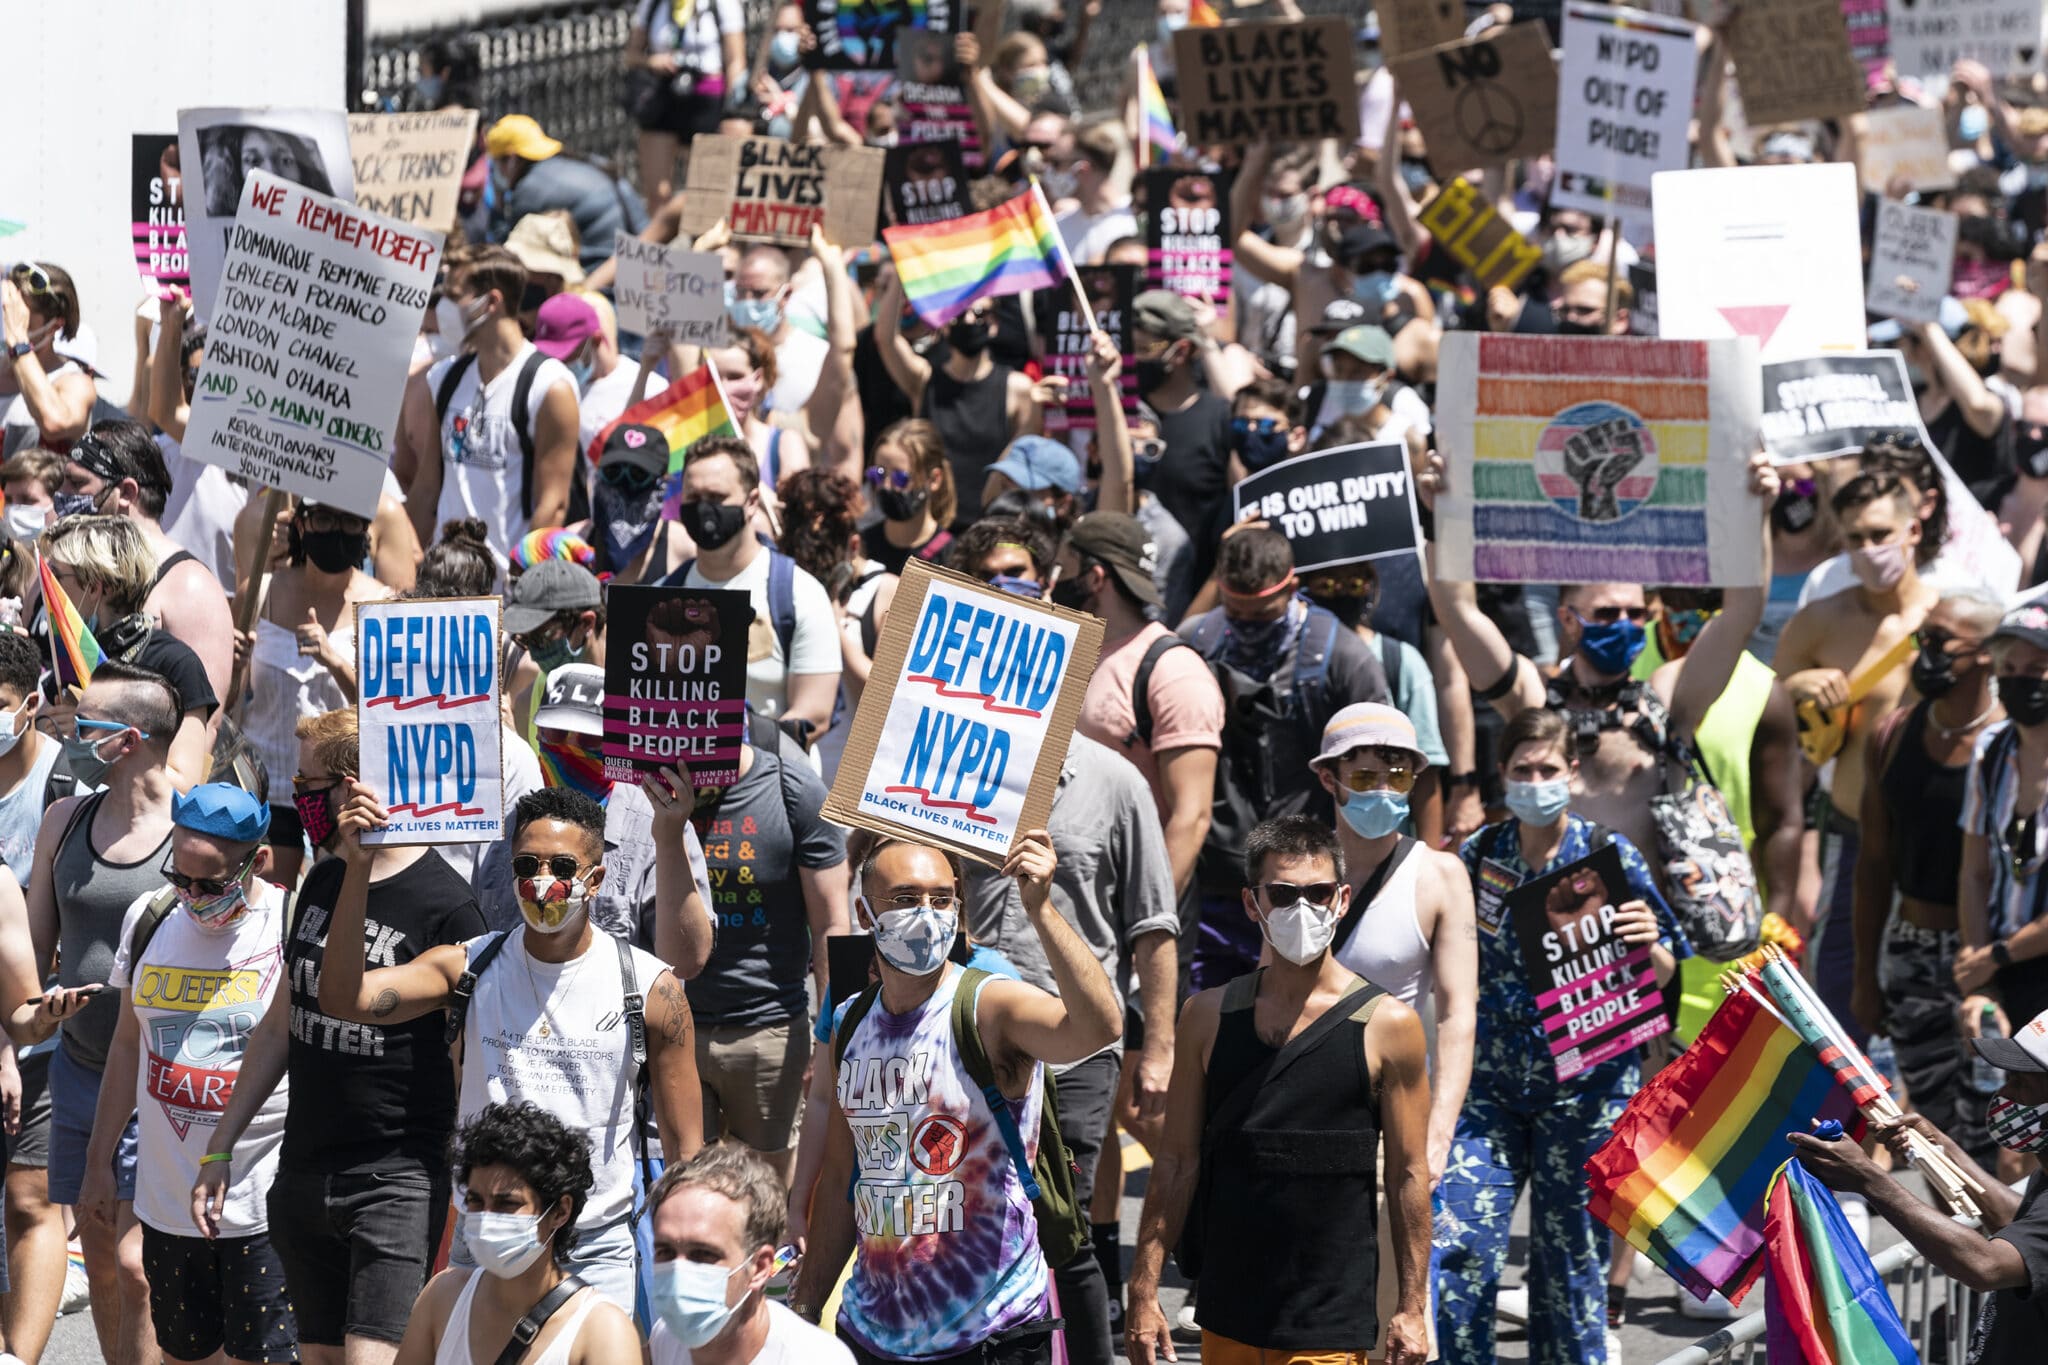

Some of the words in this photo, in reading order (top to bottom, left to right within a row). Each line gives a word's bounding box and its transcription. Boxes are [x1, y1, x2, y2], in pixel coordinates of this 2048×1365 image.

[1203, 27, 1325, 66] BLACK
[1209, 66, 1328, 102] LIVES
[1635, 88, 1669, 118] OF
[1201, 102, 1344, 140] MATTER
[740, 140, 826, 170] BLACK
[355, 188, 433, 222] OMEN
[737, 175, 826, 206] LIVES
[901, 176, 957, 207] STOP
[252, 181, 287, 217] WE
[297, 196, 436, 272] REMEMBER
[1160, 206, 1221, 234] STOP
[1418, 176, 1543, 290] BLM
[234, 224, 315, 274] DOMINIQUE
[616, 237, 673, 269] BLACK
[1161, 253, 1221, 274] BLACK
[227, 261, 299, 297] LAYLEEN
[306, 284, 387, 327] POLANCO
[617, 288, 670, 318] LIVES
[224, 286, 265, 315] TONY
[268, 301, 337, 339] McDADE
[215, 313, 280, 351] LONDON
[288, 338, 360, 379] CHANEL
[207, 338, 279, 379] ASHTON
[286, 368, 351, 410] O'HARA
[200, 371, 238, 396] AND
[241, 385, 267, 409] SO
[270, 396, 325, 430] MANY
[326, 416, 383, 450] OTHERS
[227, 416, 336, 466] REVOLUTIONARY
[239, 456, 282, 485] YOUTH
[1261, 491, 1286, 519] IS
[1288, 481, 1341, 512] OUR
[1341, 471, 1406, 503] DUTY
[1279, 510, 1315, 539] TO
[1316, 501, 1368, 533] WIN
[364, 614, 492, 698] DEFUND
[631, 642, 722, 674] STOP
[907, 594, 1066, 711] DEFUND
[629, 678, 720, 702] KILLING
[628, 706, 719, 730] BLACK
[388, 722, 477, 804] NYPD
[604, 757, 633, 769] QUEER
[628, 734, 717, 757] PEOPLE
[900, 706, 1011, 809] NYPD
[604, 770, 633, 782] MARCH
[693, 777, 720, 786] JUNE
[695, 769, 737, 778] SUNDAY
[407, 821, 441, 832] LIVES
[445, 820, 499, 830] MATTER!
[864, 792, 907, 813] BLACK
[911, 806, 949, 826] LIVES
[951, 819, 1009, 845] MATTER!
[738, 840, 755, 860] &
[737, 866, 754, 884] &
[1542, 904, 1616, 962] STOP
[1551, 938, 1628, 989] KILLING
[140, 971, 250, 1005] QUEERS
[1559, 965, 1636, 1015] BLACK
[1567, 988, 1642, 1040] PEOPLE
[156, 1011, 257, 1062] FOR
[515, 1034, 532, 1042] THE
[535, 1036, 566, 1047] DIVINE
[567, 1038, 599, 1048] BLADE
[526, 1047, 538, 1056] TO
[541, 1048, 555, 1058] MY
[556, 1050, 614, 1061] ANCESTORS
[497, 1064, 507, 1074] TO
[504, 1053, 514, 1063] TO
[147, 1058, 236, 1106] FEAR
[837, 1052, 929, 1111] BLACK
